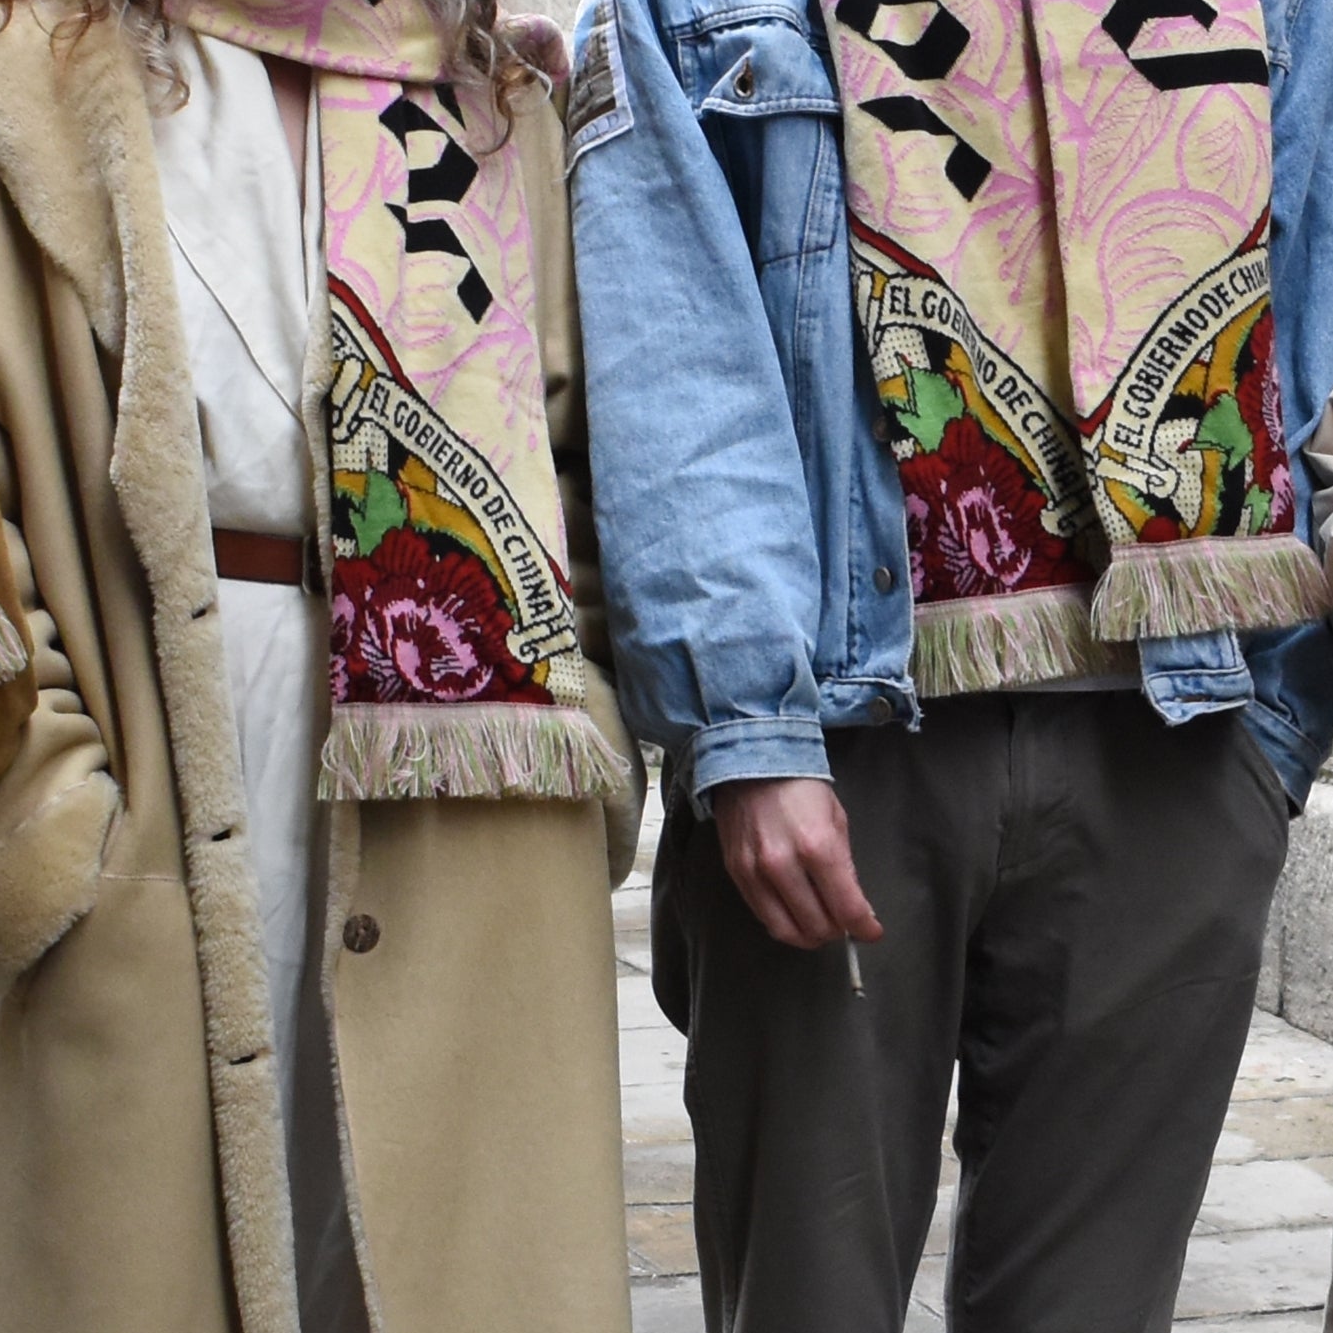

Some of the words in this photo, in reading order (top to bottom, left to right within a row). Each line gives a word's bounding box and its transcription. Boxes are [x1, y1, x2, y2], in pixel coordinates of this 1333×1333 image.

[1198, 281, 1237, 320] DE
[889, 284, 917, 319] EL
[921, 288, 998, 384] GOBIERNO
[993, 375, 1033, 416] DE
[1020, 408, 1082, 493] CHINA
[1122, 307, 1210, 420] GOBIERNO
[1113, 422, 1147, 450] EL
[368, 382, 391, 421] EL
[393, 400, 489, 500] GOBIERNO
[481, 494, 517, 535] DE
[502, 533, 556, 620] CHINA
